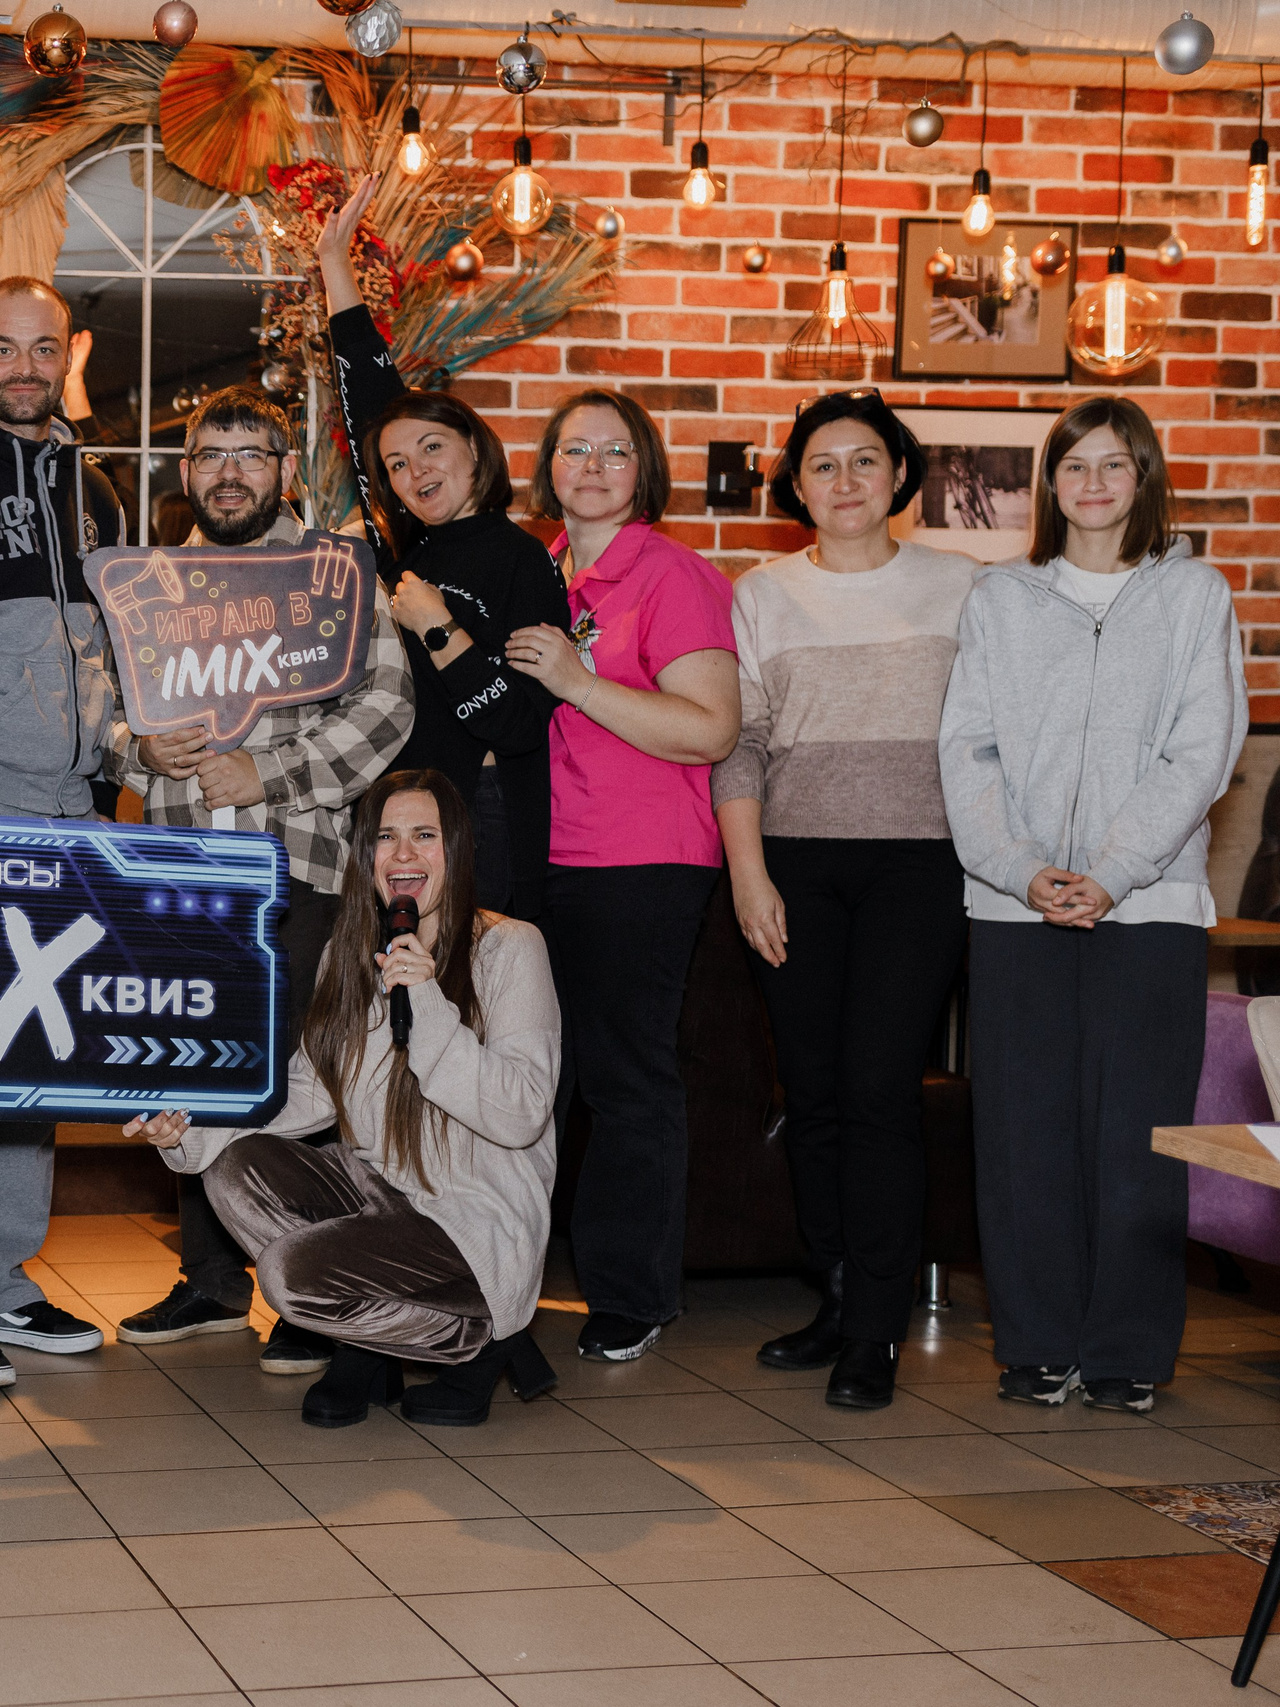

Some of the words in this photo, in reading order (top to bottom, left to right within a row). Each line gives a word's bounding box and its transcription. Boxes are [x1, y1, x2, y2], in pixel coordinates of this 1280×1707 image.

[155, 596, 276, 645] ИГРАЮ
[289, 592, 312, 626] В
[161, 634, 282, 700] IMIX
[277, 645, 329, 669] КВИЗ
[456, 676, 508, 720] BRAND
[81, 974, 216, 1017] КВИЗ
